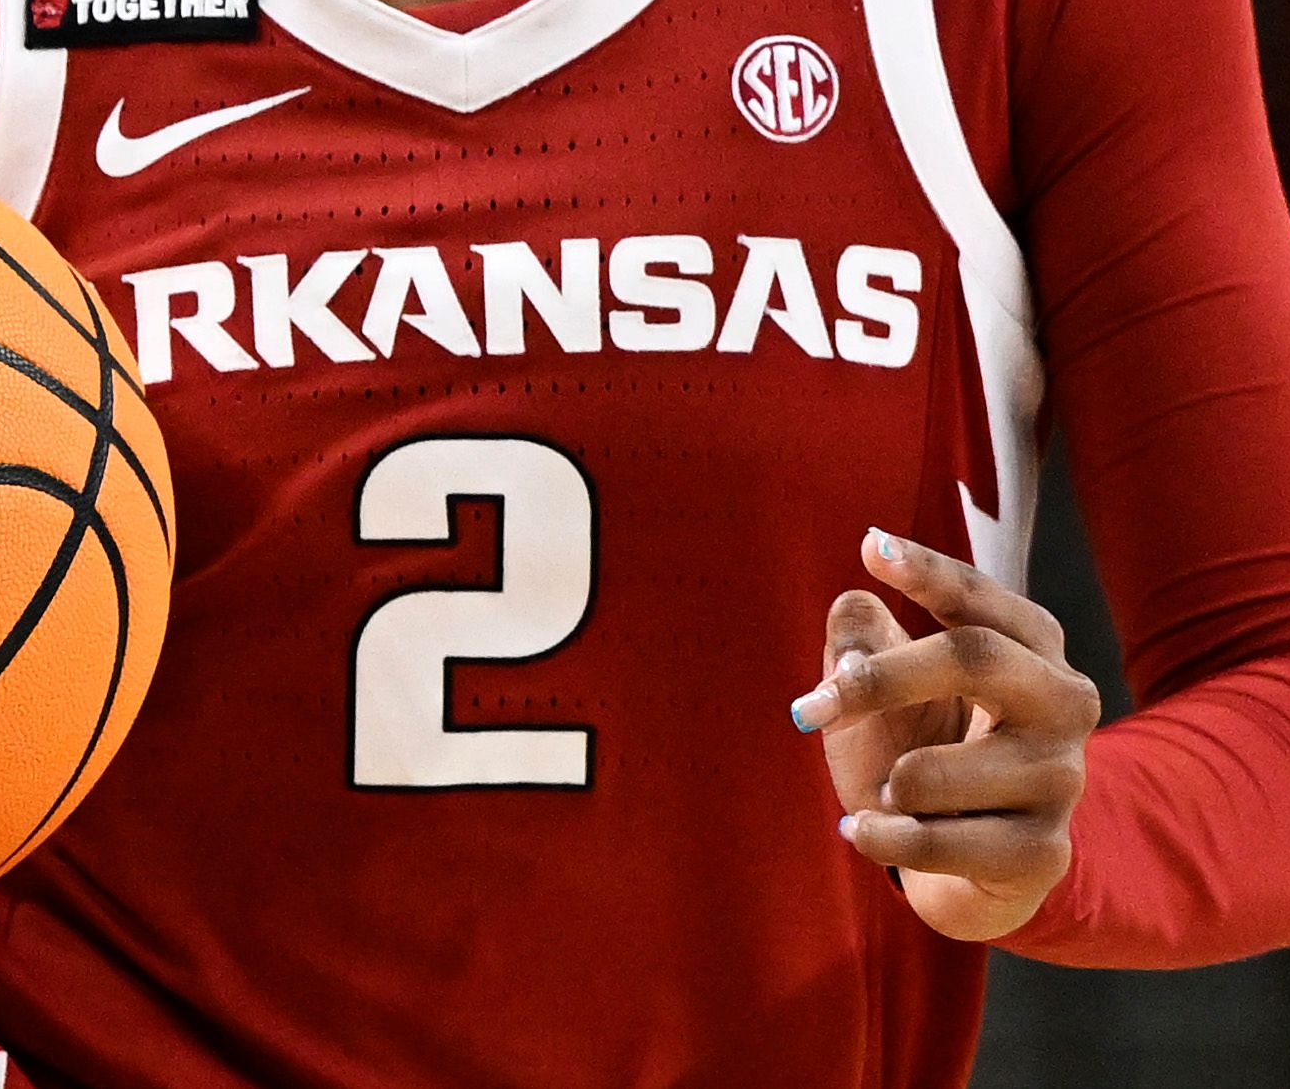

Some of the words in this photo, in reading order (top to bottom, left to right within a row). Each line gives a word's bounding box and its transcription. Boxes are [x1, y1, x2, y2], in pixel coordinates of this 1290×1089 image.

[742, 43, 829, 133] SEC
[120, 233, 924, 386] RKANSAS
[348, 433, 596, 790] 2
